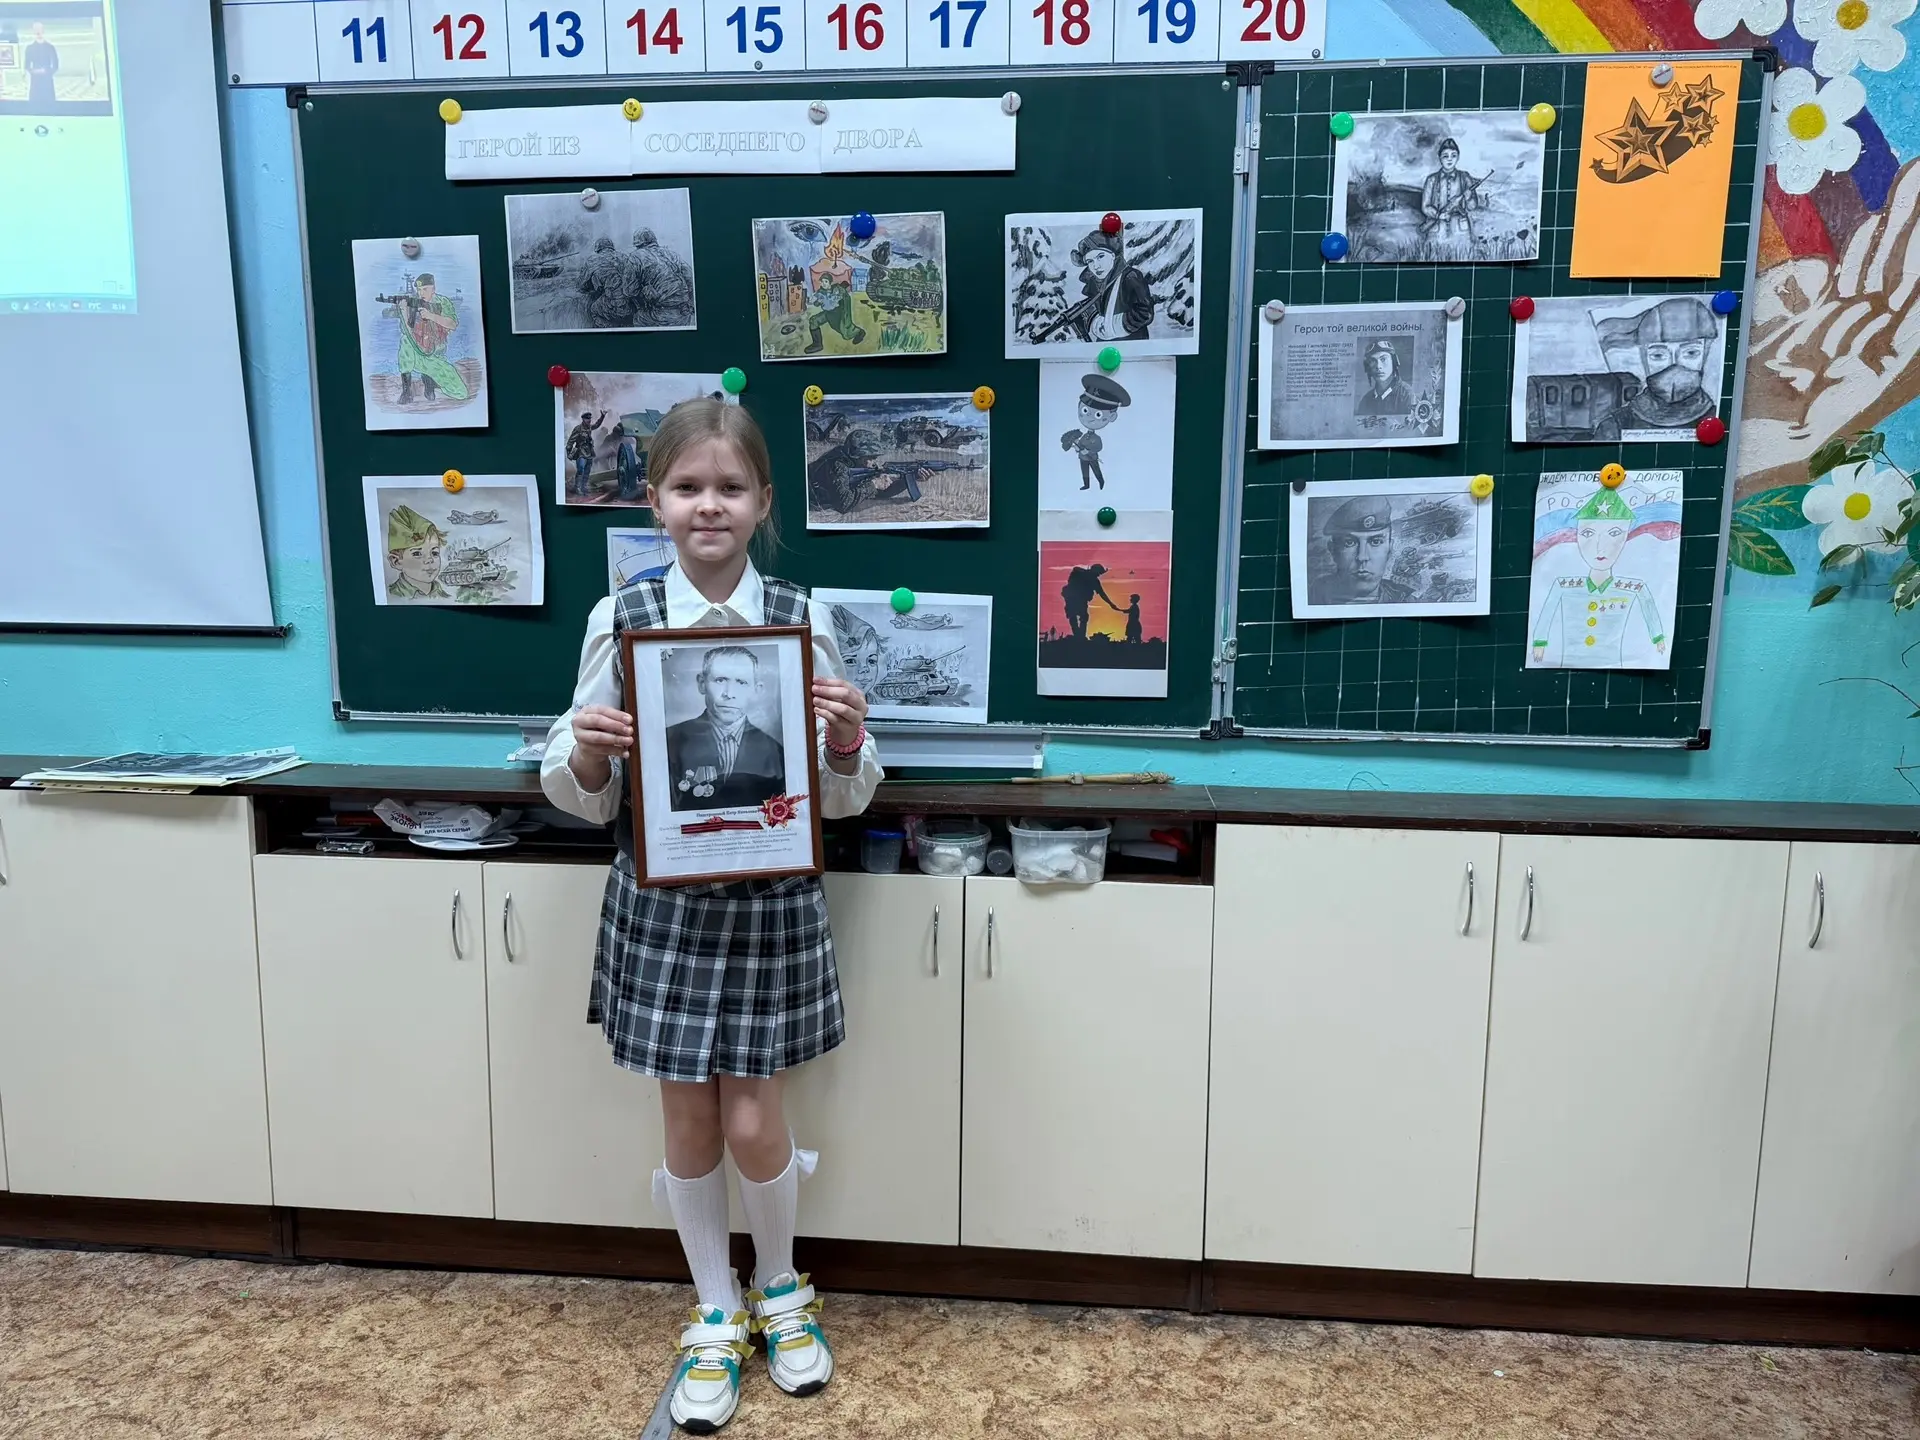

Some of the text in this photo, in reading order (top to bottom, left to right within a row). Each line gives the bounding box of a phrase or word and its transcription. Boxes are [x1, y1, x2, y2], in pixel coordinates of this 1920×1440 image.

[342, 0, 1305, 62] 11 12 13 14 15 16 17 18 19 20
[458, 128, 923, 158] ГЕРОЙ ИЗ СОСЕДНЕГО ДВОРА
[1294, 322, 1425, 335] Герои той великой войны.
[1633, 471, 1682, 484] ДОМОЙ!
